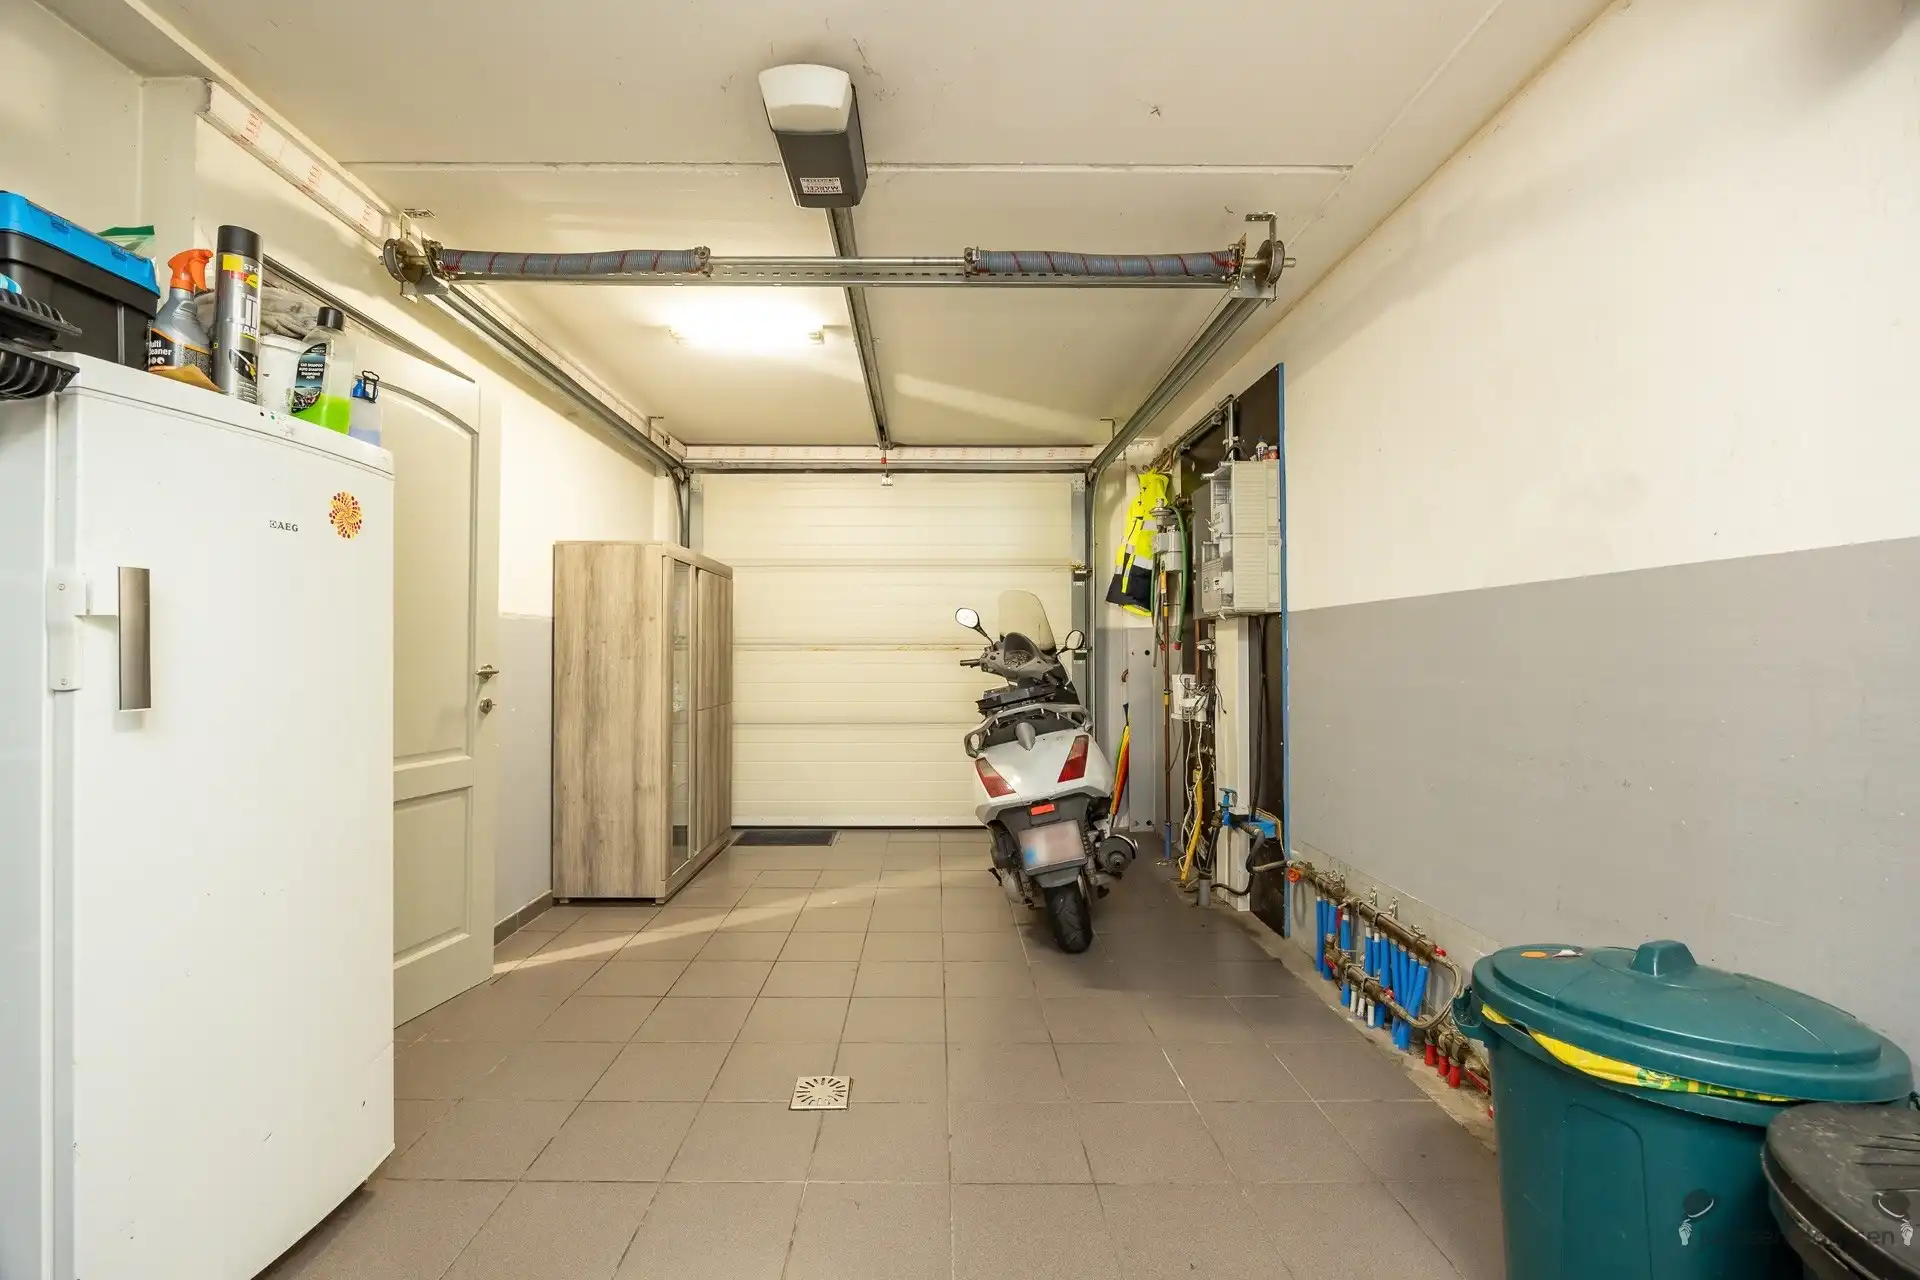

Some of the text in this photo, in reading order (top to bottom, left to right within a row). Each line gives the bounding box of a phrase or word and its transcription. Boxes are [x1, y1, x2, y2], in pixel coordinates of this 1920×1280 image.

[149, 339, 162, 348] ulti
[149, 348, 172, 356] leaner
[278, 522, 298, 532] AEG
